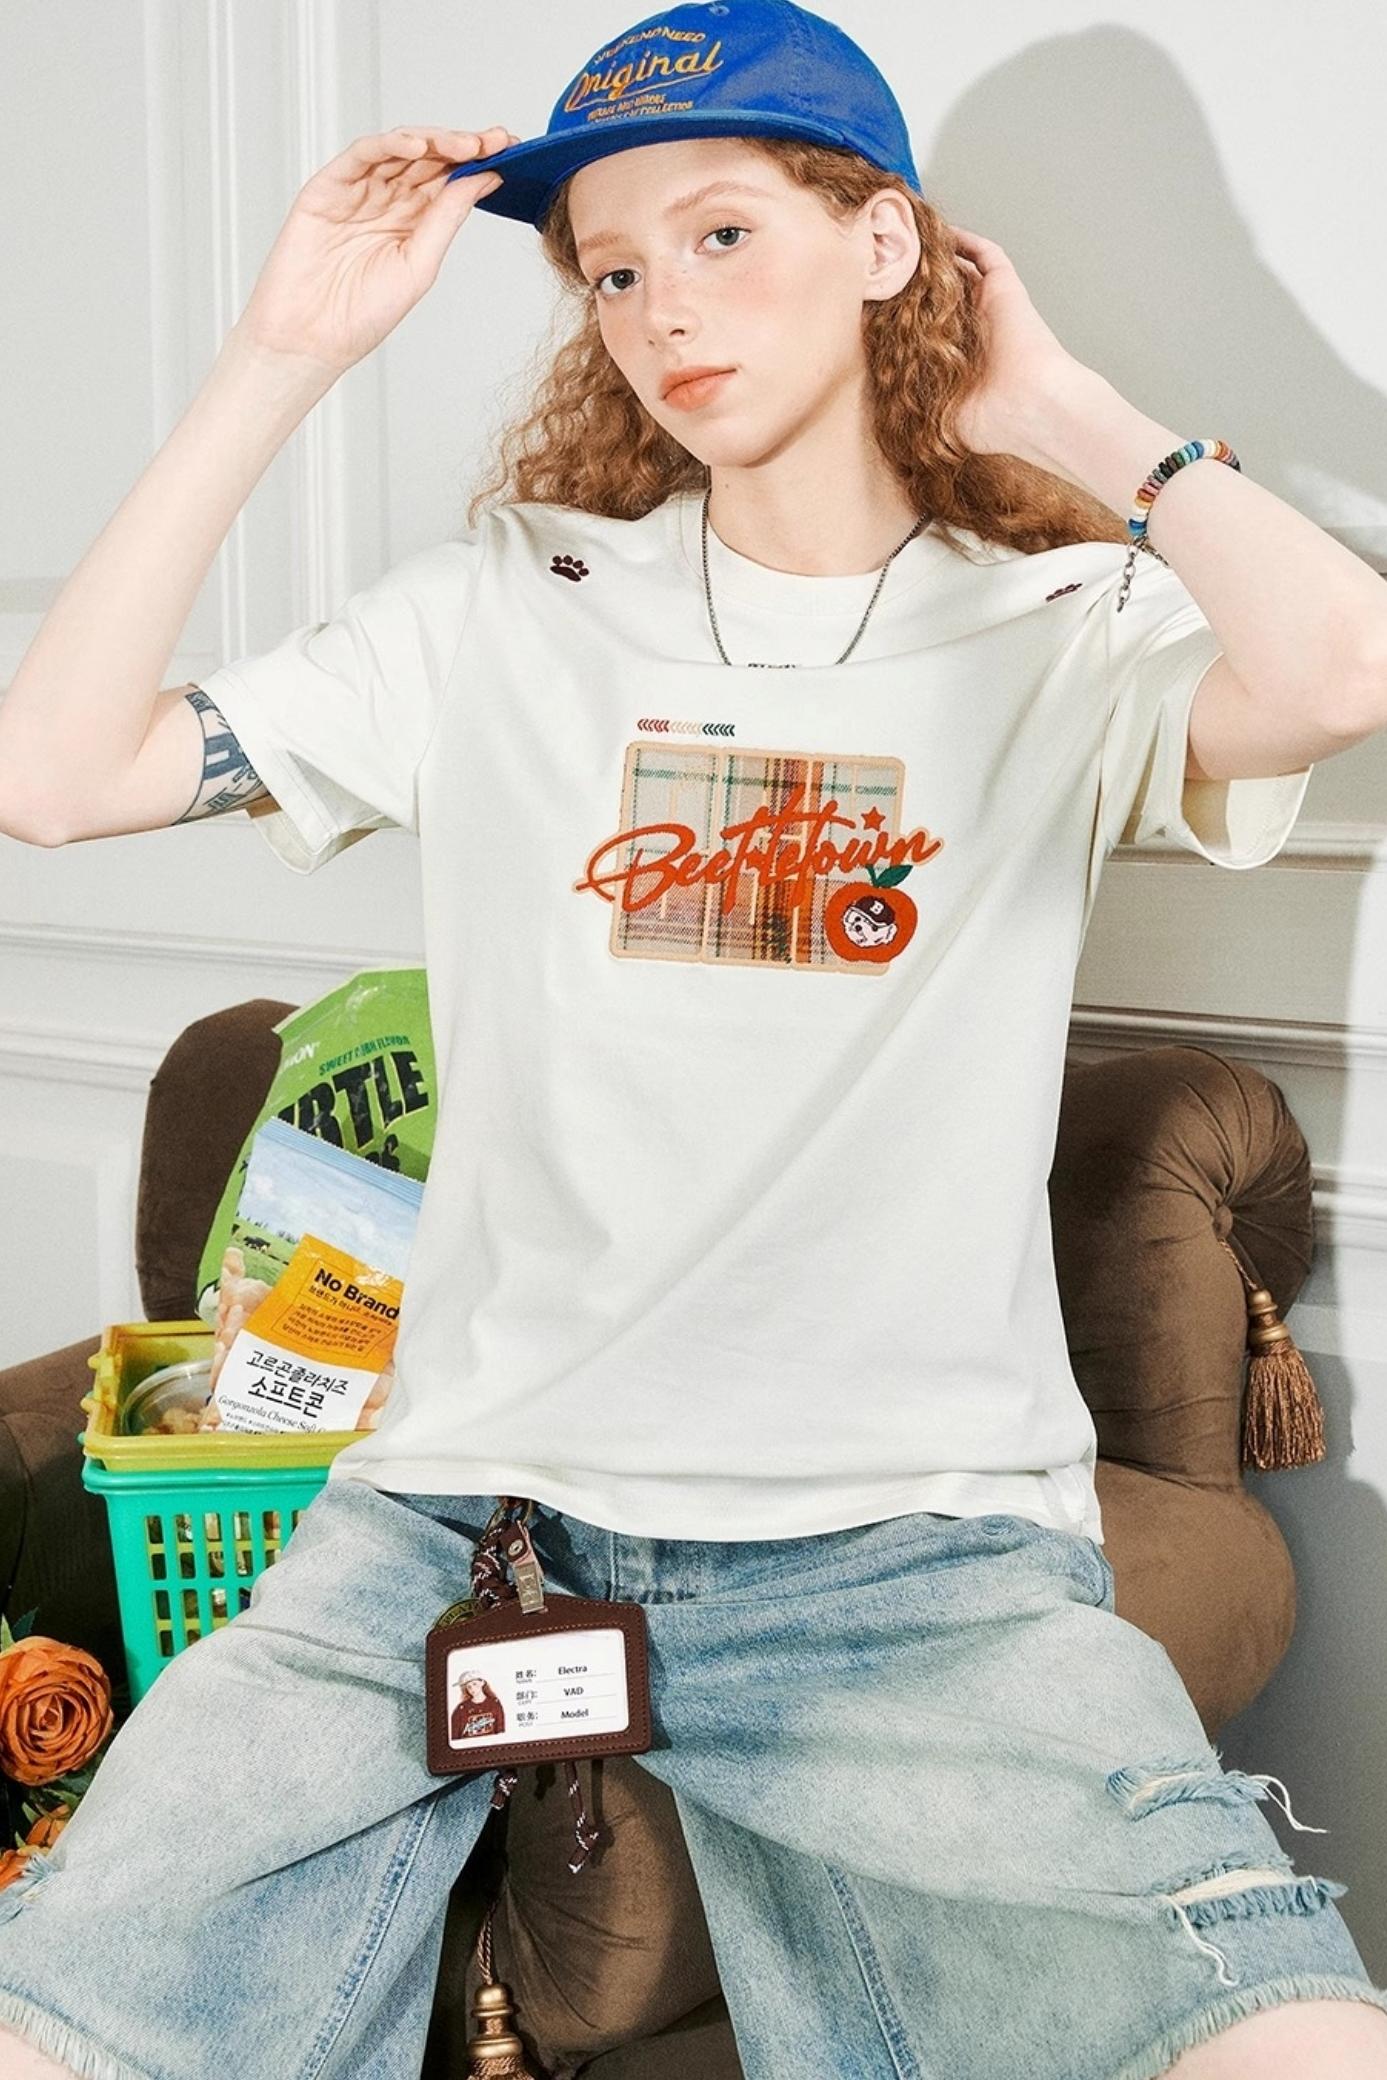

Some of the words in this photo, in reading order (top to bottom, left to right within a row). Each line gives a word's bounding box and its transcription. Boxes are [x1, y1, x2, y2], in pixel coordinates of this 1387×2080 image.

[661, 27, 706, 43] NEED
[869, 900, 885, 916] B
[319, 1050, 353, 1077] SWEET
[278, 1050, 430, 1150] RTLE
[314, 1267, 343, 1293] No
[343, 1283, 400, 1320] Brand
[247, 1376, 325, 1419] 소프트콘
[218, 1395, 267, 1418] Gorgonzola
[267, 1410, 299, 1428] Cheese
[558, 1665, 588, 1676] Electra
[563, 1686, 584, 1697] VAD
[560, 1708, 589, 1720] Model
